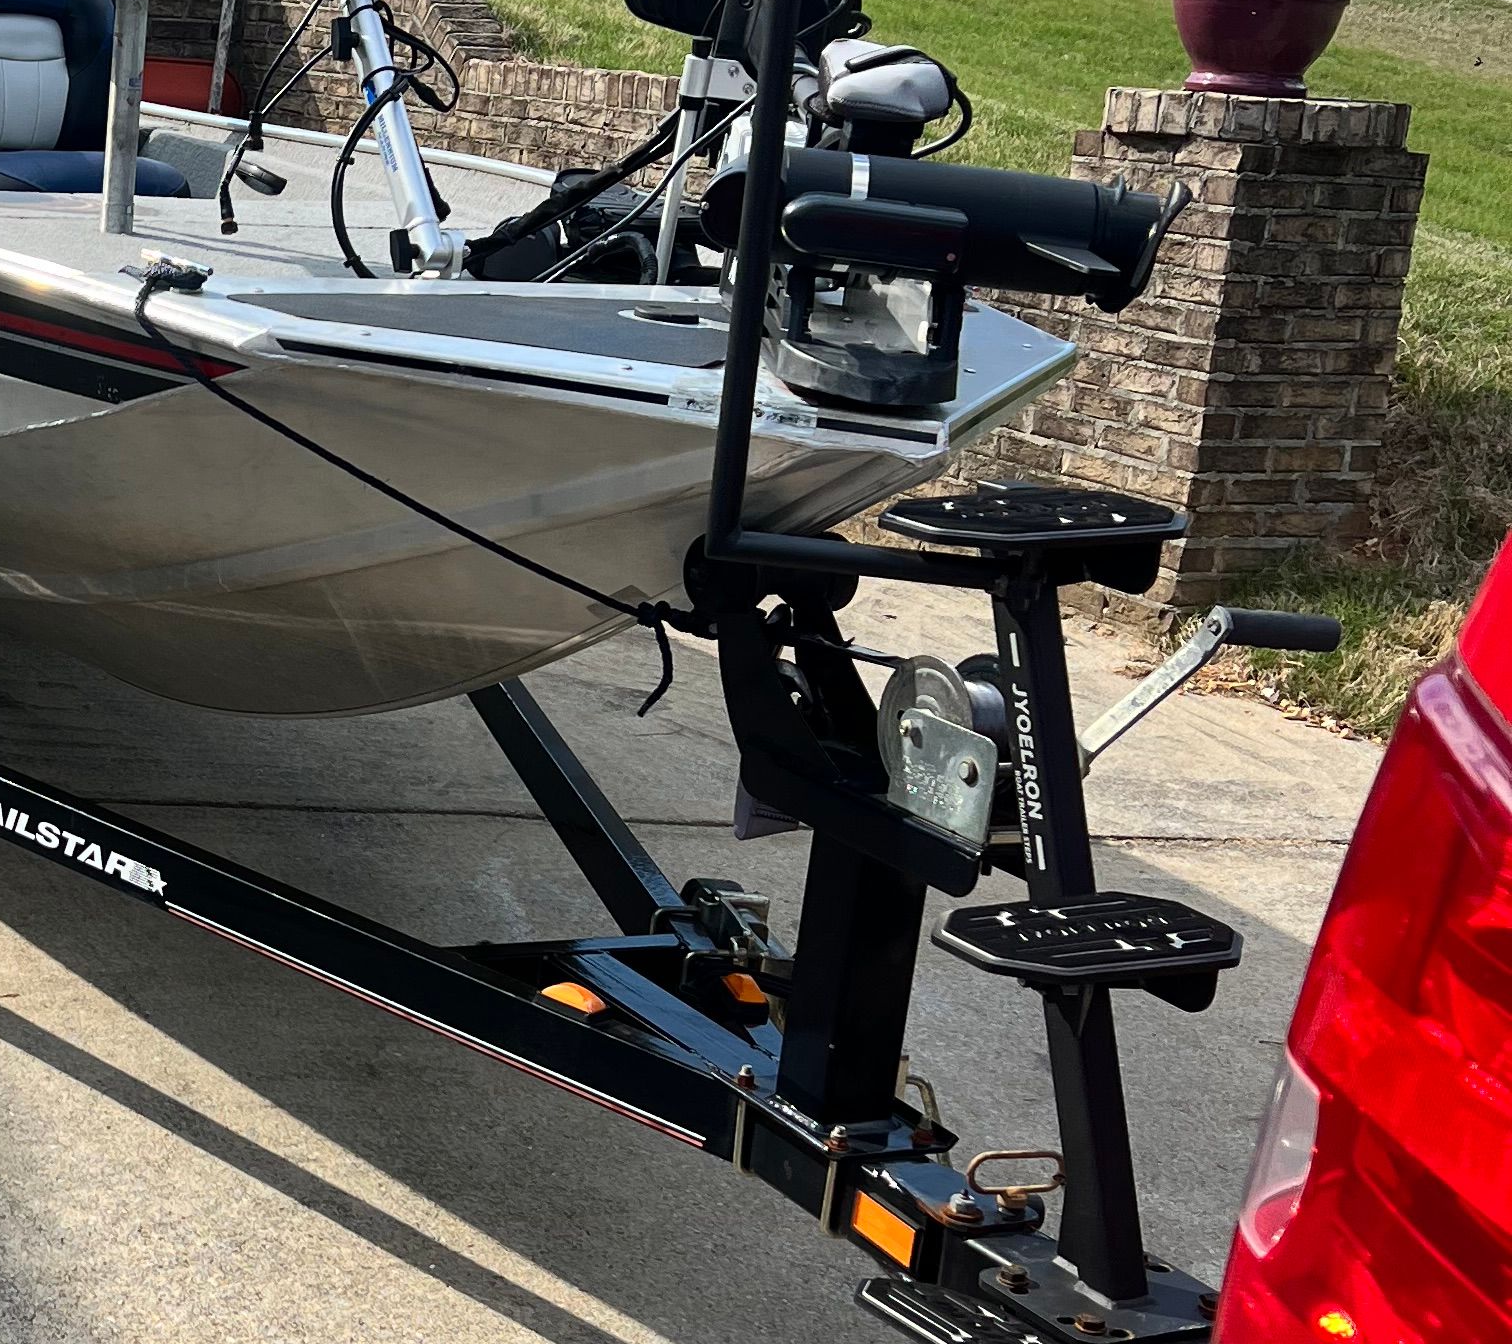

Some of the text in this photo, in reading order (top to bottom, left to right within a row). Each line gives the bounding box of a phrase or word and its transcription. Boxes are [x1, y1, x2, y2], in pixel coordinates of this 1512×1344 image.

[1011, 682, 1044, 821] JYOELRON
[1014, 769, 1033, 864] BOAT TRAILER STEPS
